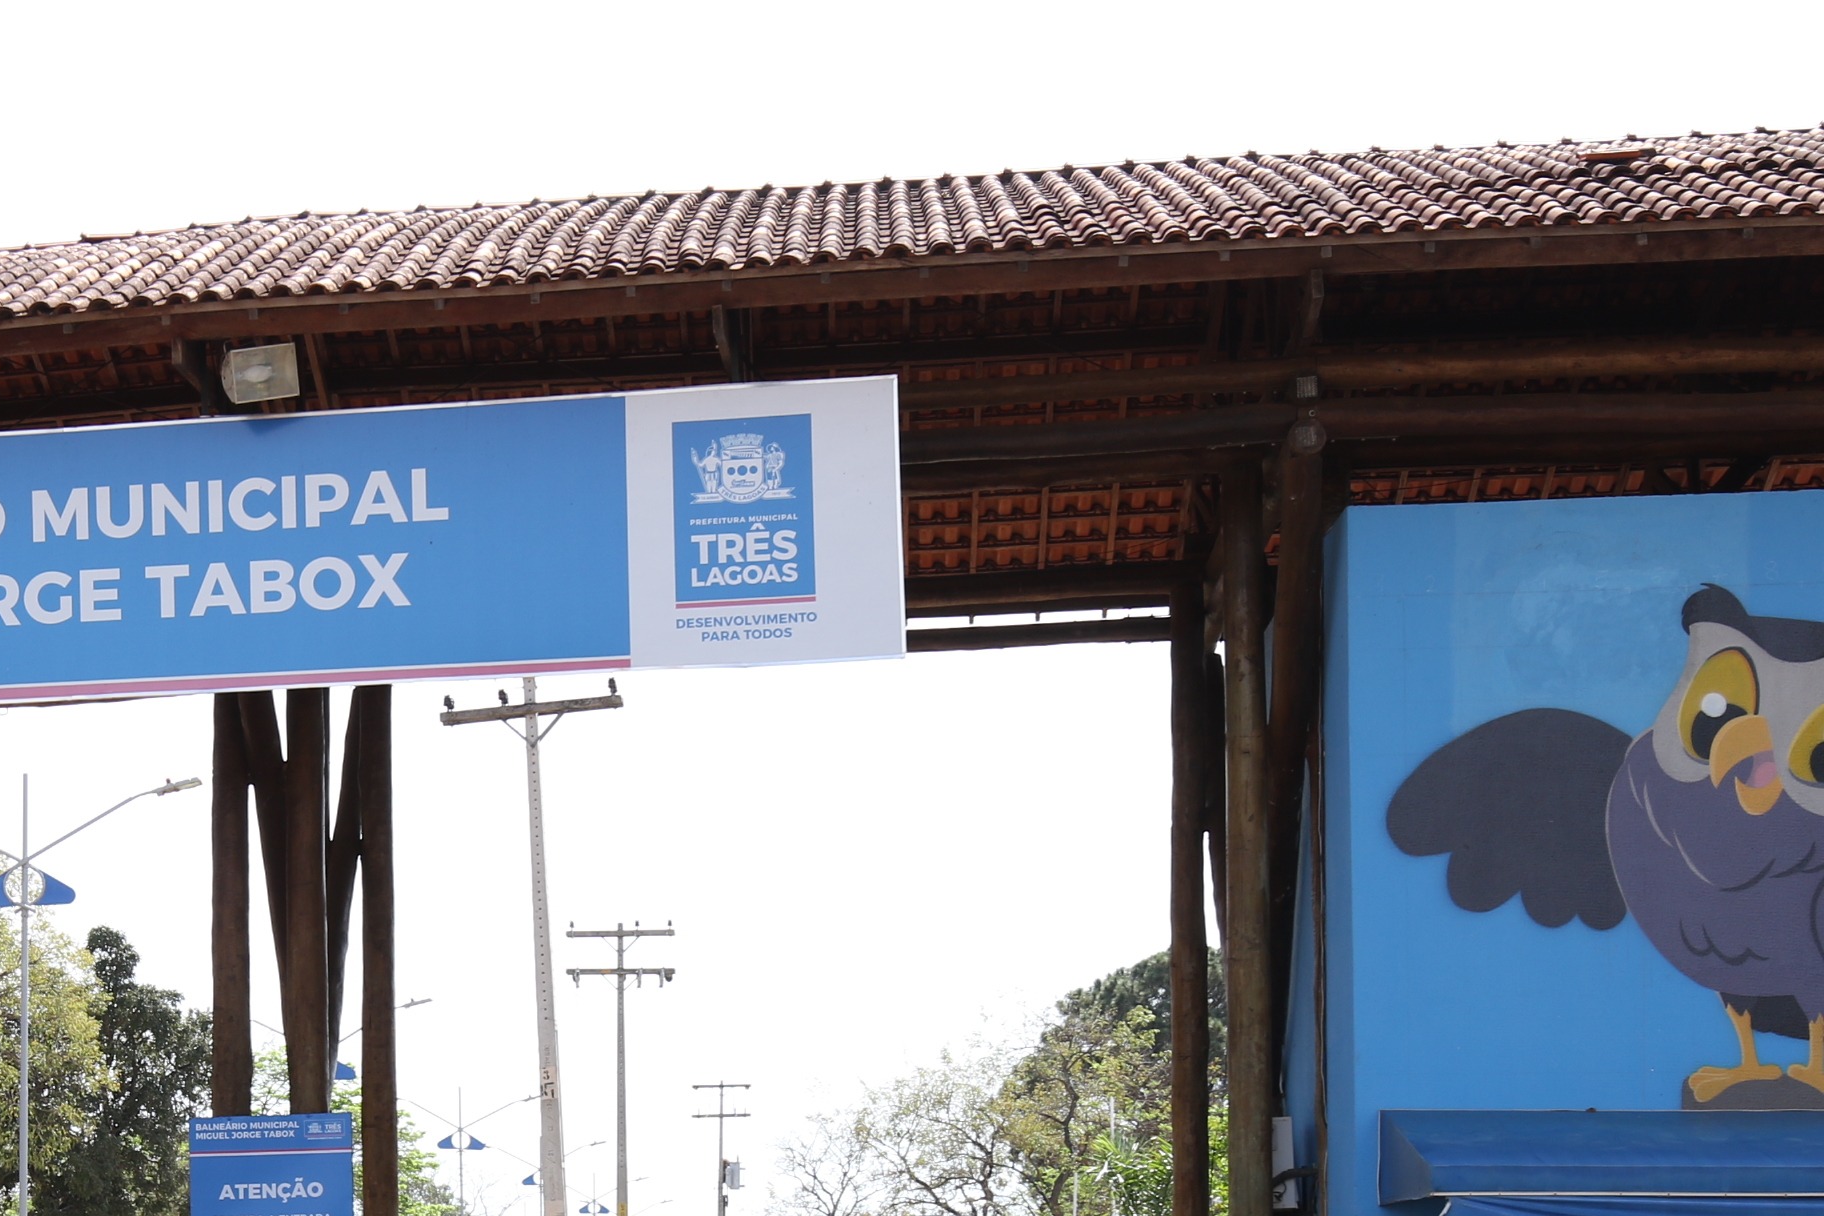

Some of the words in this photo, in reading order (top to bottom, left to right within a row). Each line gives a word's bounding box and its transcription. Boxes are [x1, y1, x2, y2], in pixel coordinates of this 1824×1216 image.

[31, 468, 450, 543] MUNICIPAL
[689, 516, 746, 526] PREFEITURA
[748, 513, 798, 522] MUNICIPAL
[690, 522, 798, 565] TRÊS
[145, 552, 411, 618] TABOX
[691, 562, 798, 588] LAGOAS
[676, 611, 818, 629] DESENVOLVIMENTO
[701, 631, 740, 642] PARA
[743, 627, 792, 640] TODOS
[195, 1121, 248, 1131] BALNEÁRIO
[249, 1120, 300, 1130] MUNICIPAL
[195, 1131, 230, 1140] MIGUEL
[231, 1131, 262, 1139] JORGE
[263, 1130, 295, 1138] TABOX
[219, 1177, 324, 1203] ATENÇÃO
